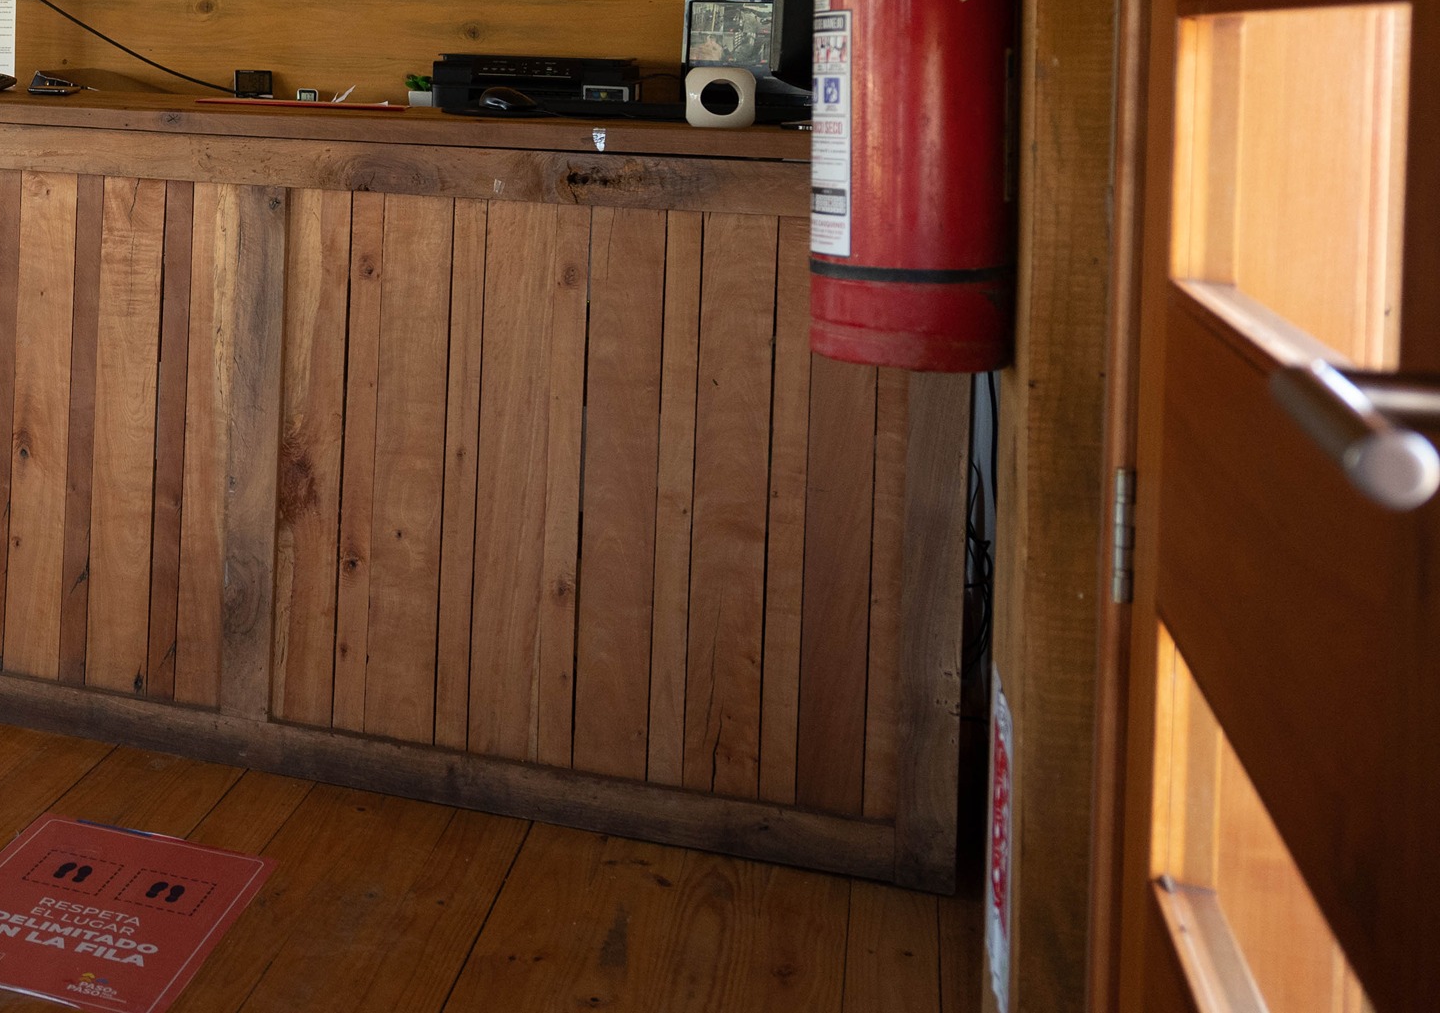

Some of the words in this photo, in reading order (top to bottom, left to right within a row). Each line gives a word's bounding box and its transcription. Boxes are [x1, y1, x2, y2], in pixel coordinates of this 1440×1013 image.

[825, 120, 843, 135] SECO
[30, 906, 54, 919] EL
[61, 913, 135, 936] LUGAR
[39, 897, 140, 927] RESPETA
[25, 931, 65, 949] LA
[74, 942, 144, 967] FILA
[66, 984, 100, 996] PASO
[79, 981, 113, 993] PASO
